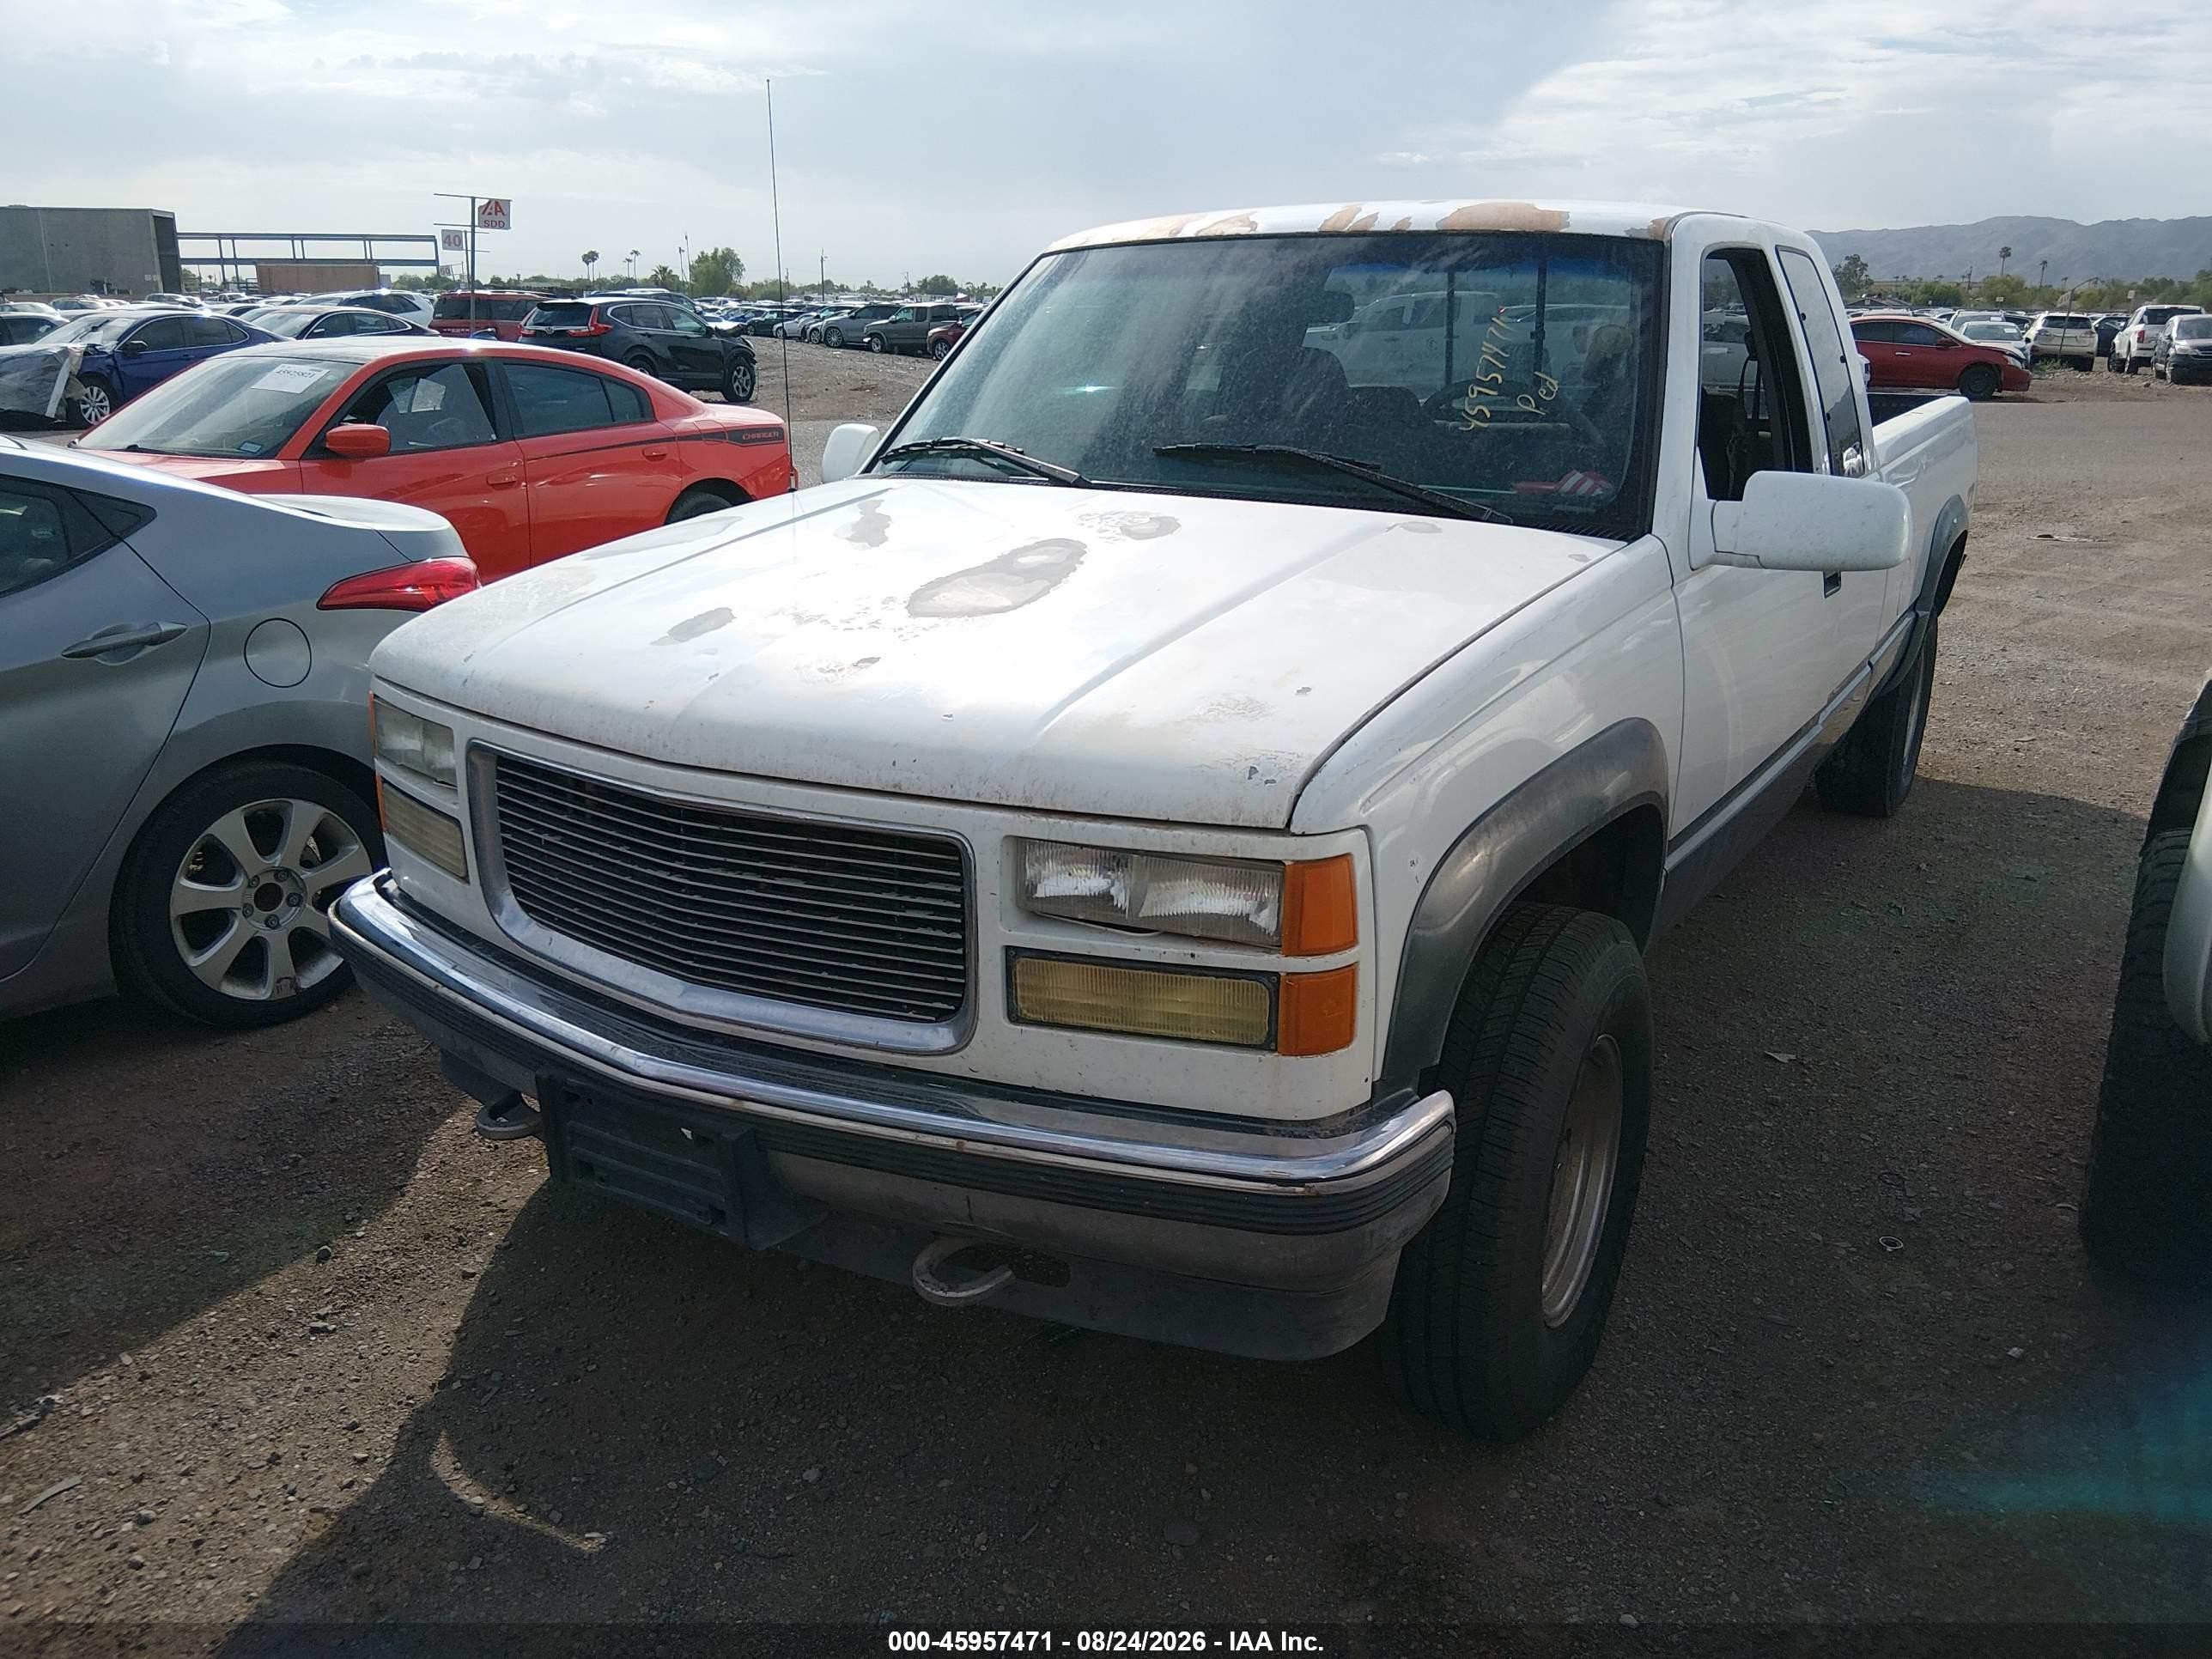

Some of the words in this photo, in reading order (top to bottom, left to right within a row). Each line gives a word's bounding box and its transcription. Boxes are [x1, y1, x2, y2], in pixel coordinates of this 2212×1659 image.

[483, 220, 505, 228] SDD
[443, 234, 462, 247] 40
[1458, 317, 1516, 431] 45957471
